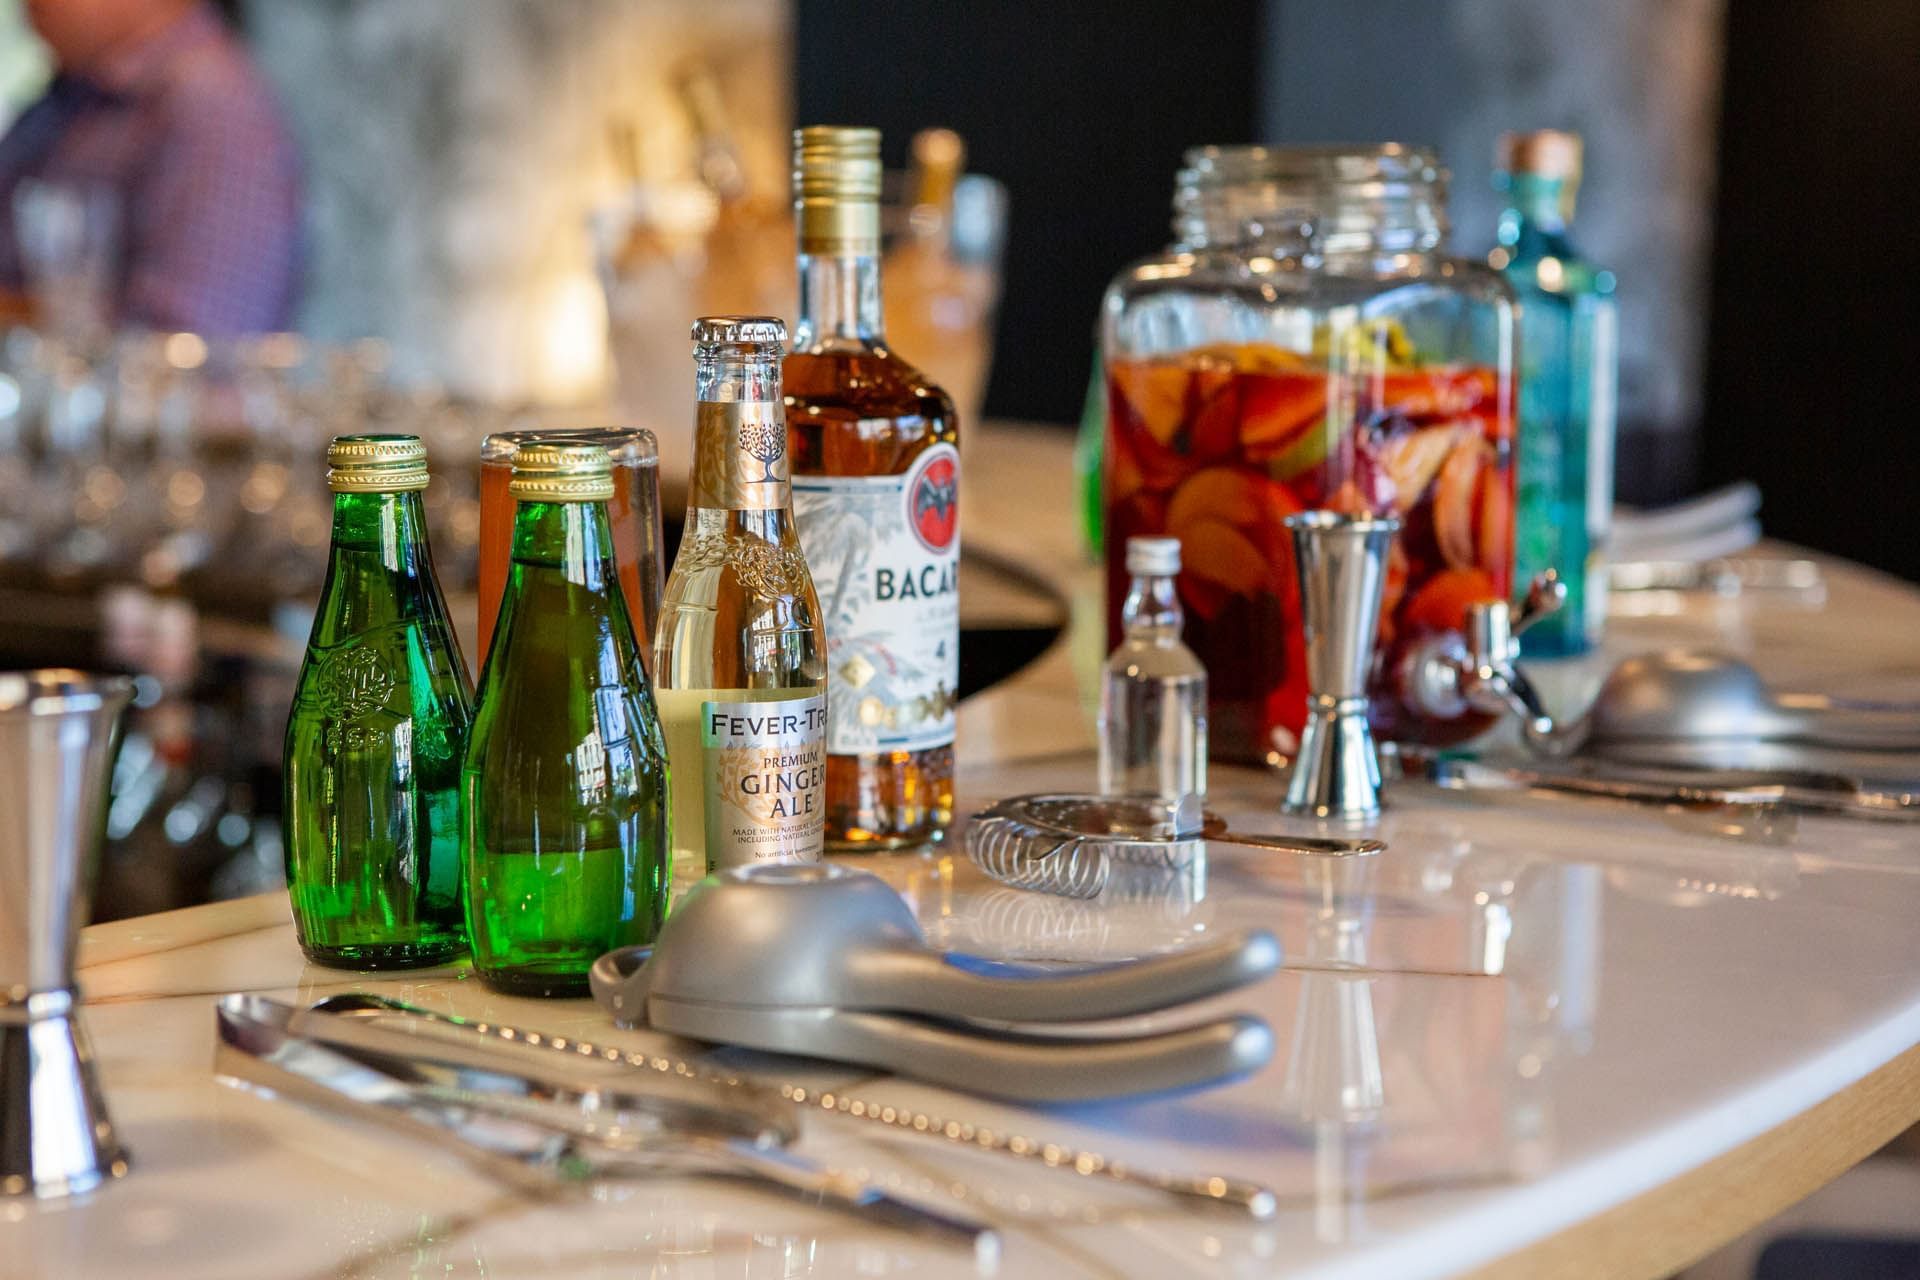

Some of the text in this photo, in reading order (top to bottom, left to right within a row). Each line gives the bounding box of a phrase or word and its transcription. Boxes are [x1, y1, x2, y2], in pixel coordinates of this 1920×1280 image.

[711, 706, 828, 736] FEVER-TR
[763, 751, 818, 768] PREMIUM
[770, 793, 812, 818] ALE
[732, 828, 756, 836] MADE
[738, 836, 780, 844] INCLUDING
